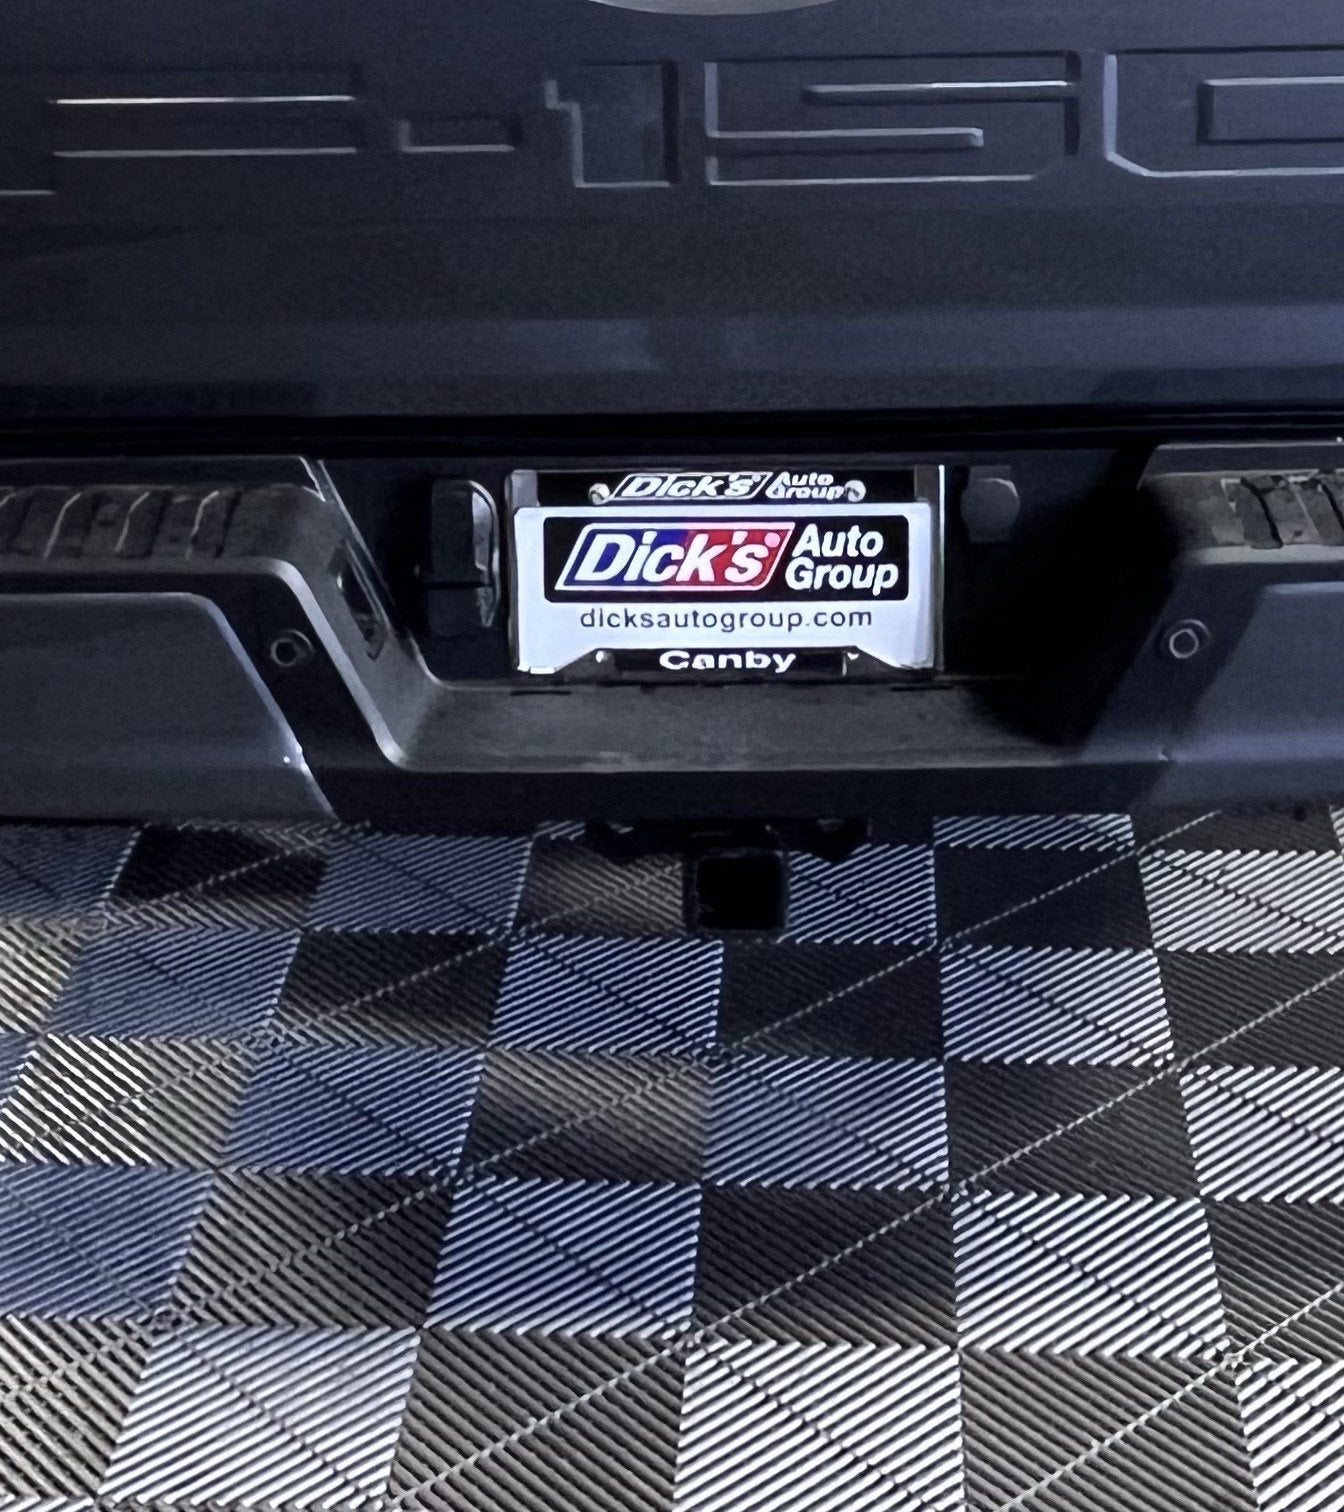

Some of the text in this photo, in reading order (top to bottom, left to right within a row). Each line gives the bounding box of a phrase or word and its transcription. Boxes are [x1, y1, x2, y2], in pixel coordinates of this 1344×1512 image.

[774, 471, 835, 487] Auto
[792, 524, 884, 559] Auto
[785, 560, 899, 595] Group
[580, 608, 873, 634] dicksautogroup.com
[659, 650, 797, 674] Canby
